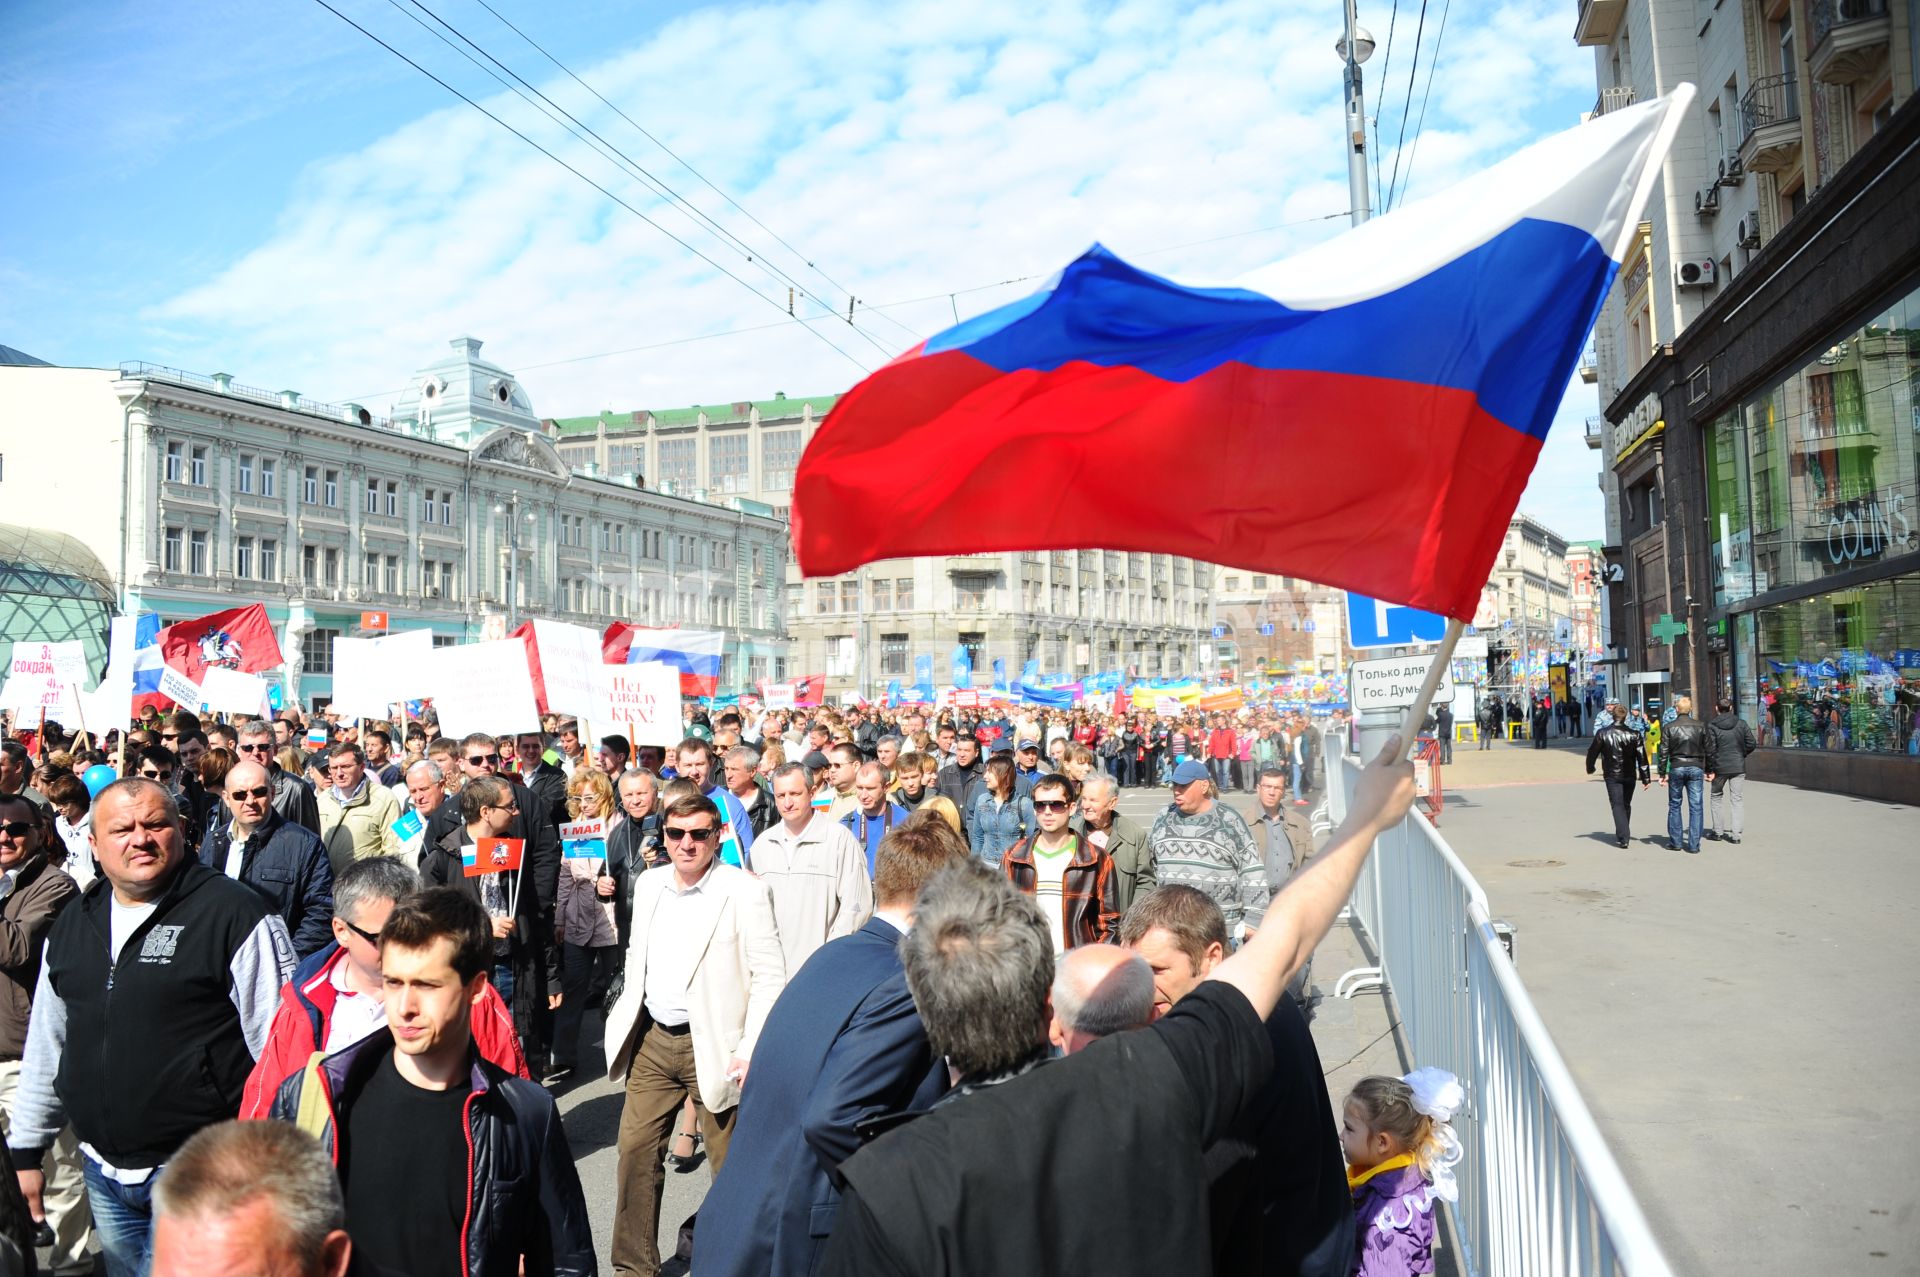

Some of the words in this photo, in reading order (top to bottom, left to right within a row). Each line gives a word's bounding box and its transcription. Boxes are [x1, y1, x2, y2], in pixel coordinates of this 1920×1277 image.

[1614, 391, 1662, 455] ЕВРОСЕТЬ
[1827, 486, 1909, 565] COLIN'S
[1358, 668, 1400, 681] Только
[1403, 666, 1425, 677] для
[613, 676, 641, 693] Нет
[1363, 687, 1387, 698] Гос.
[572, 823, 601, 836] МАЯ
[145, 924, 186, 941] GET
